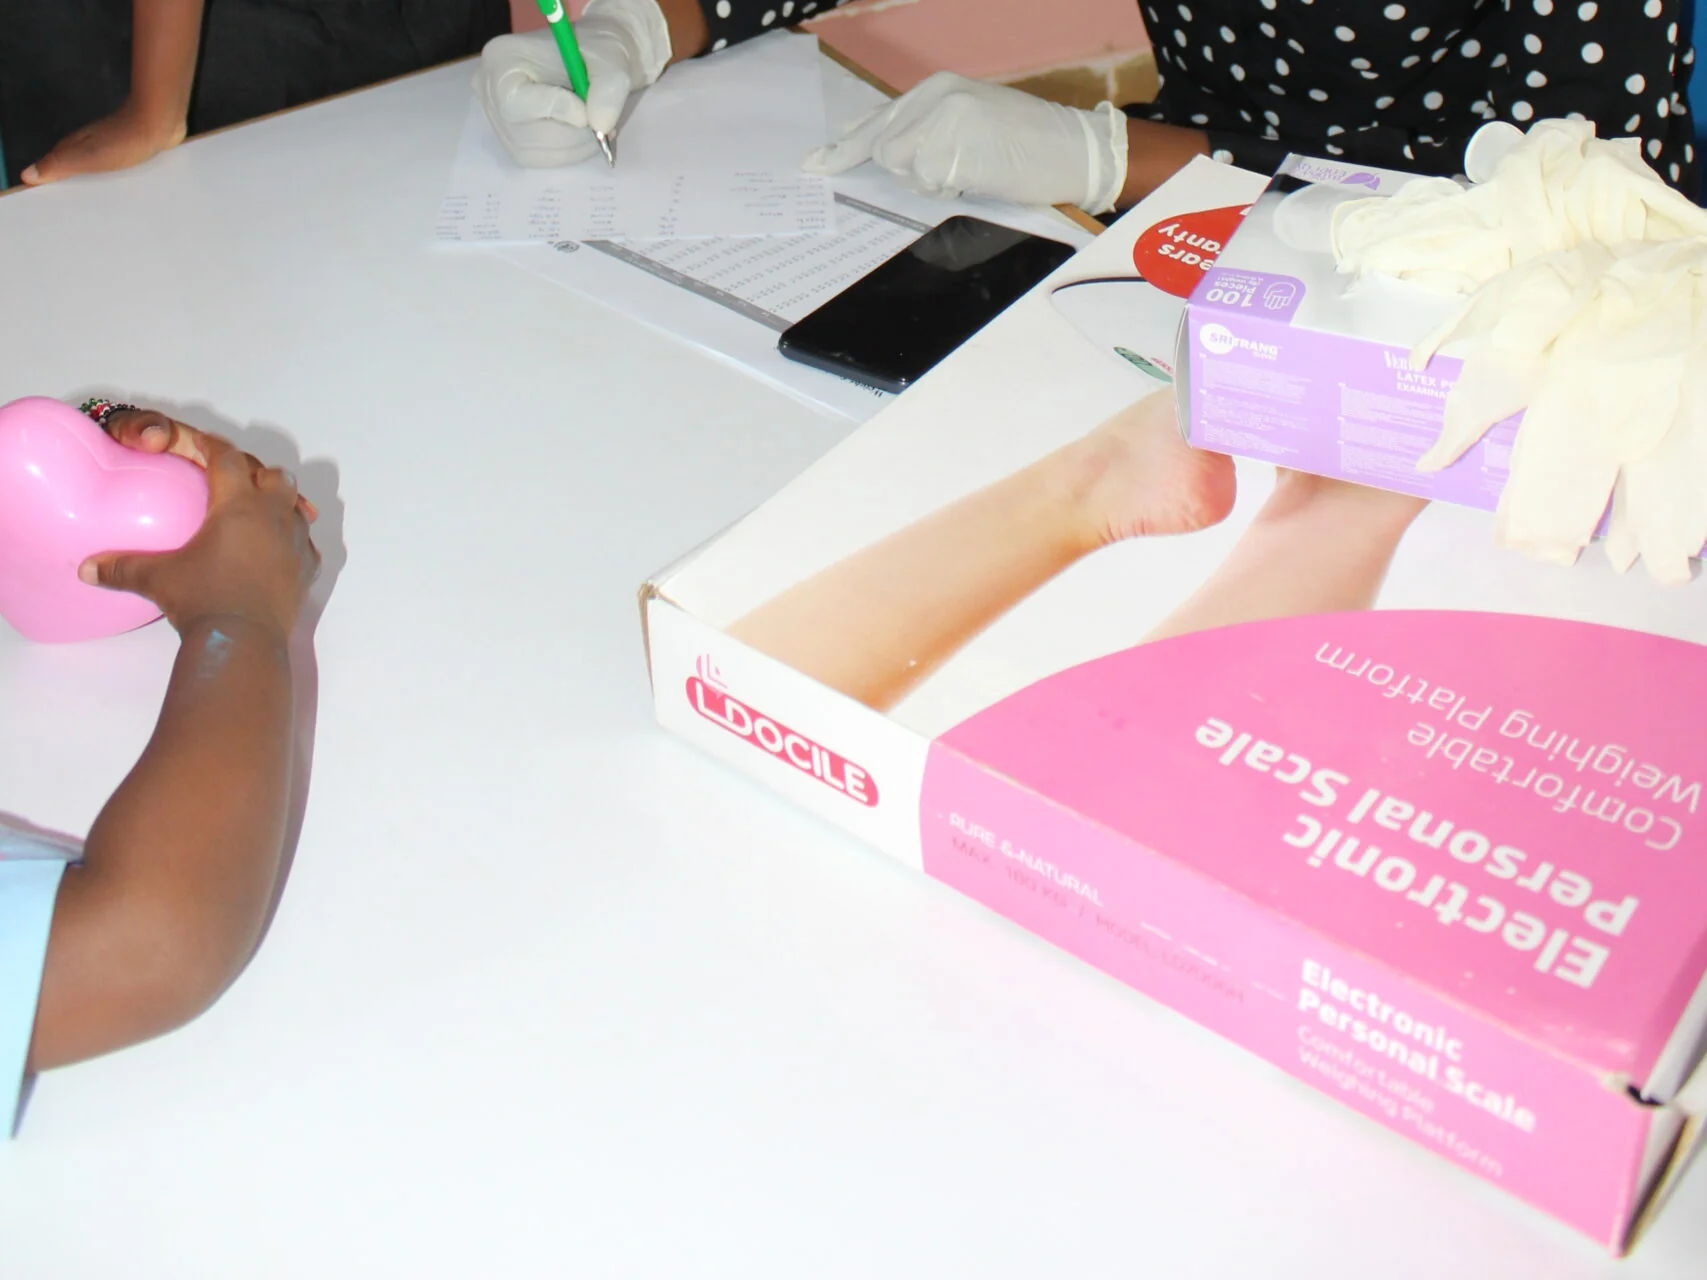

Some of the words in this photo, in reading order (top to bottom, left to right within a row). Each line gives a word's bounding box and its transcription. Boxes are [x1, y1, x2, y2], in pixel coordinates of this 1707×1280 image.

[1158, 223, 1221, 254] anty
[1158, 243, 1214, 271] ears
[1206, 288, 1252, 308] 100
[1214, 280, 1256, 295] Pieces
[1209, 332, 1279, 356] SRITRANG
[1397, 370, 1437, 387] LATEX
[1396, 381, 1448, 400] EXAMINA
[1315, 641, 1493, 733] Platform
[1195, 717, 1350, 808] Scale
[1407, 721, 1684, 852] Comfortable
[1498, 709, 1703, 813] Weighing
[949, 811, 996, 849] PURE
[1015, 846, 1105, 908] NATURAL
[1282, 814, 1611, 989] Electronic
[1347, 788, 1640, 937] Personal
[1301, 958, 1463, 1062] Electronic
[1298, 987, 1439, 1081] Personal
[1443, 1064, 1537, 1134] Scale
[1298, 1024, 1436, 1113] Comfortable
[1298, 1047, 1398, 1120] Weighing
[1402, 1104, 1504, 1177] Platform
